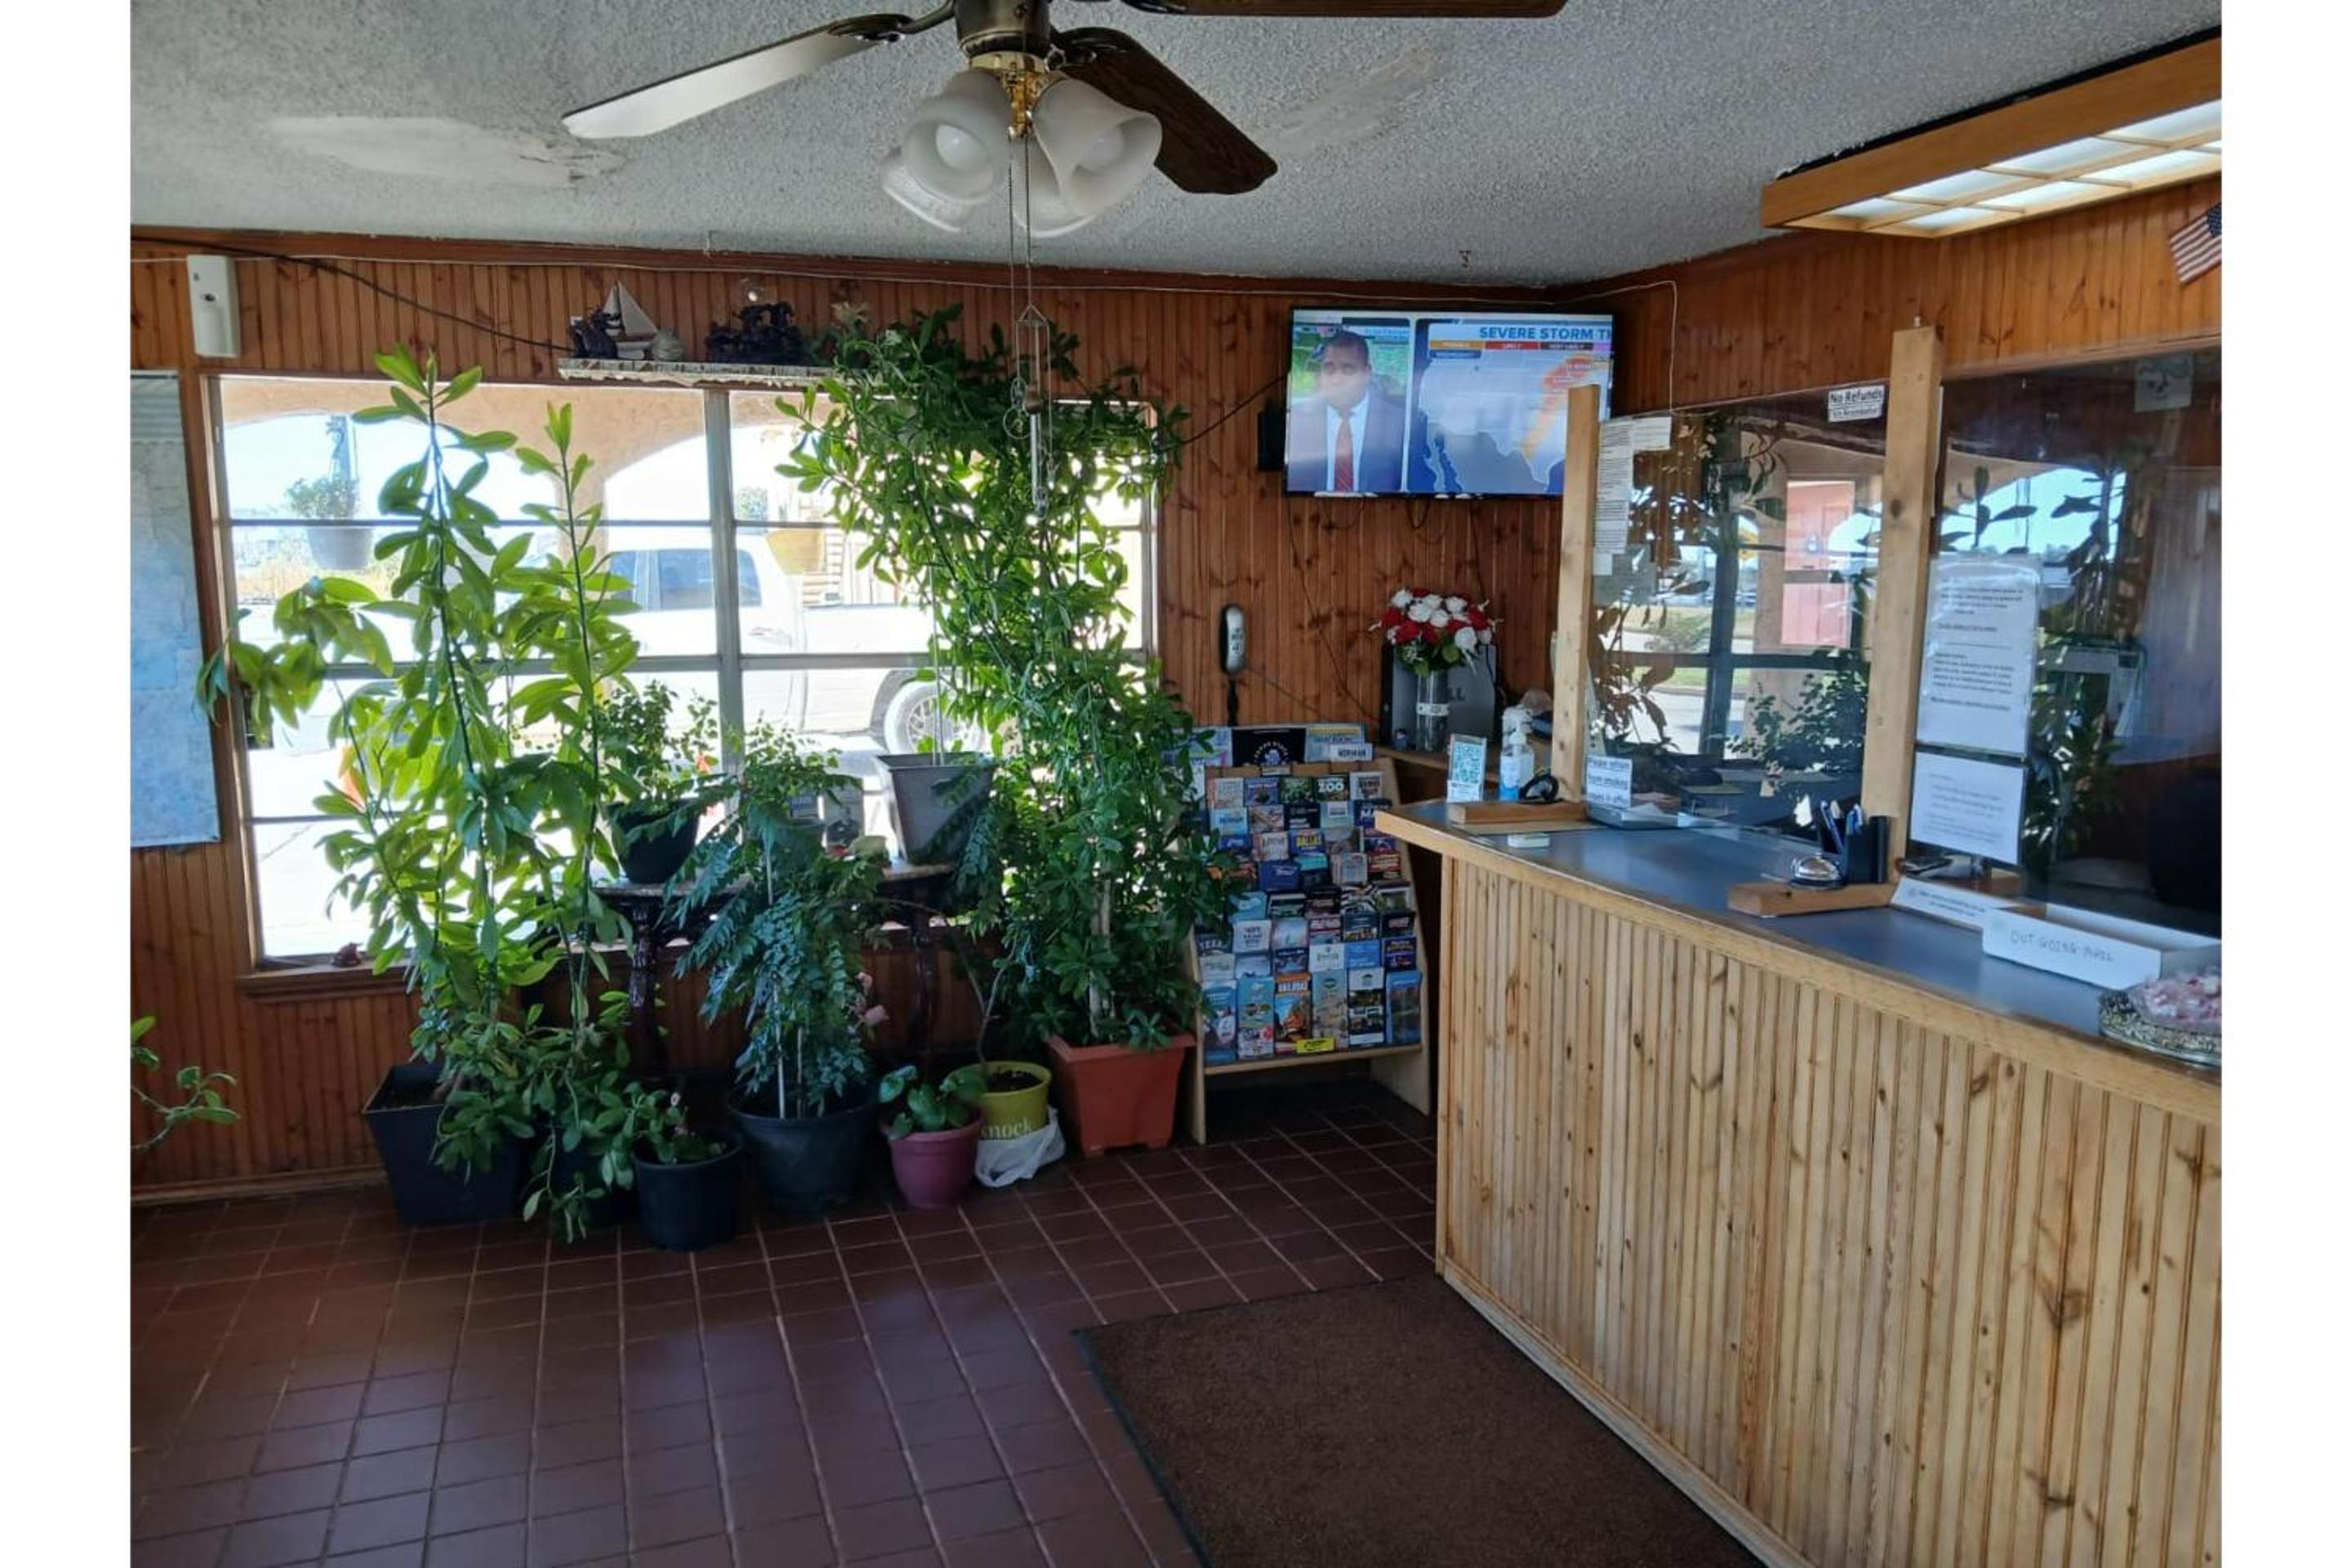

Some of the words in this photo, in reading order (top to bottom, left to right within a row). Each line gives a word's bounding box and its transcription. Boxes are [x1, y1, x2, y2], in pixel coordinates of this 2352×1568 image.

[1480, 327, 1536, 339] SEVERE
[1540, 327, 1594, 341] STORM
[1830, 393, 1843, 404] No
[1846, 389, 1882, 403] Refunds
[1318, 781, 1345, 793] ZOO
[2010, 929, 2037, 945] OUT
